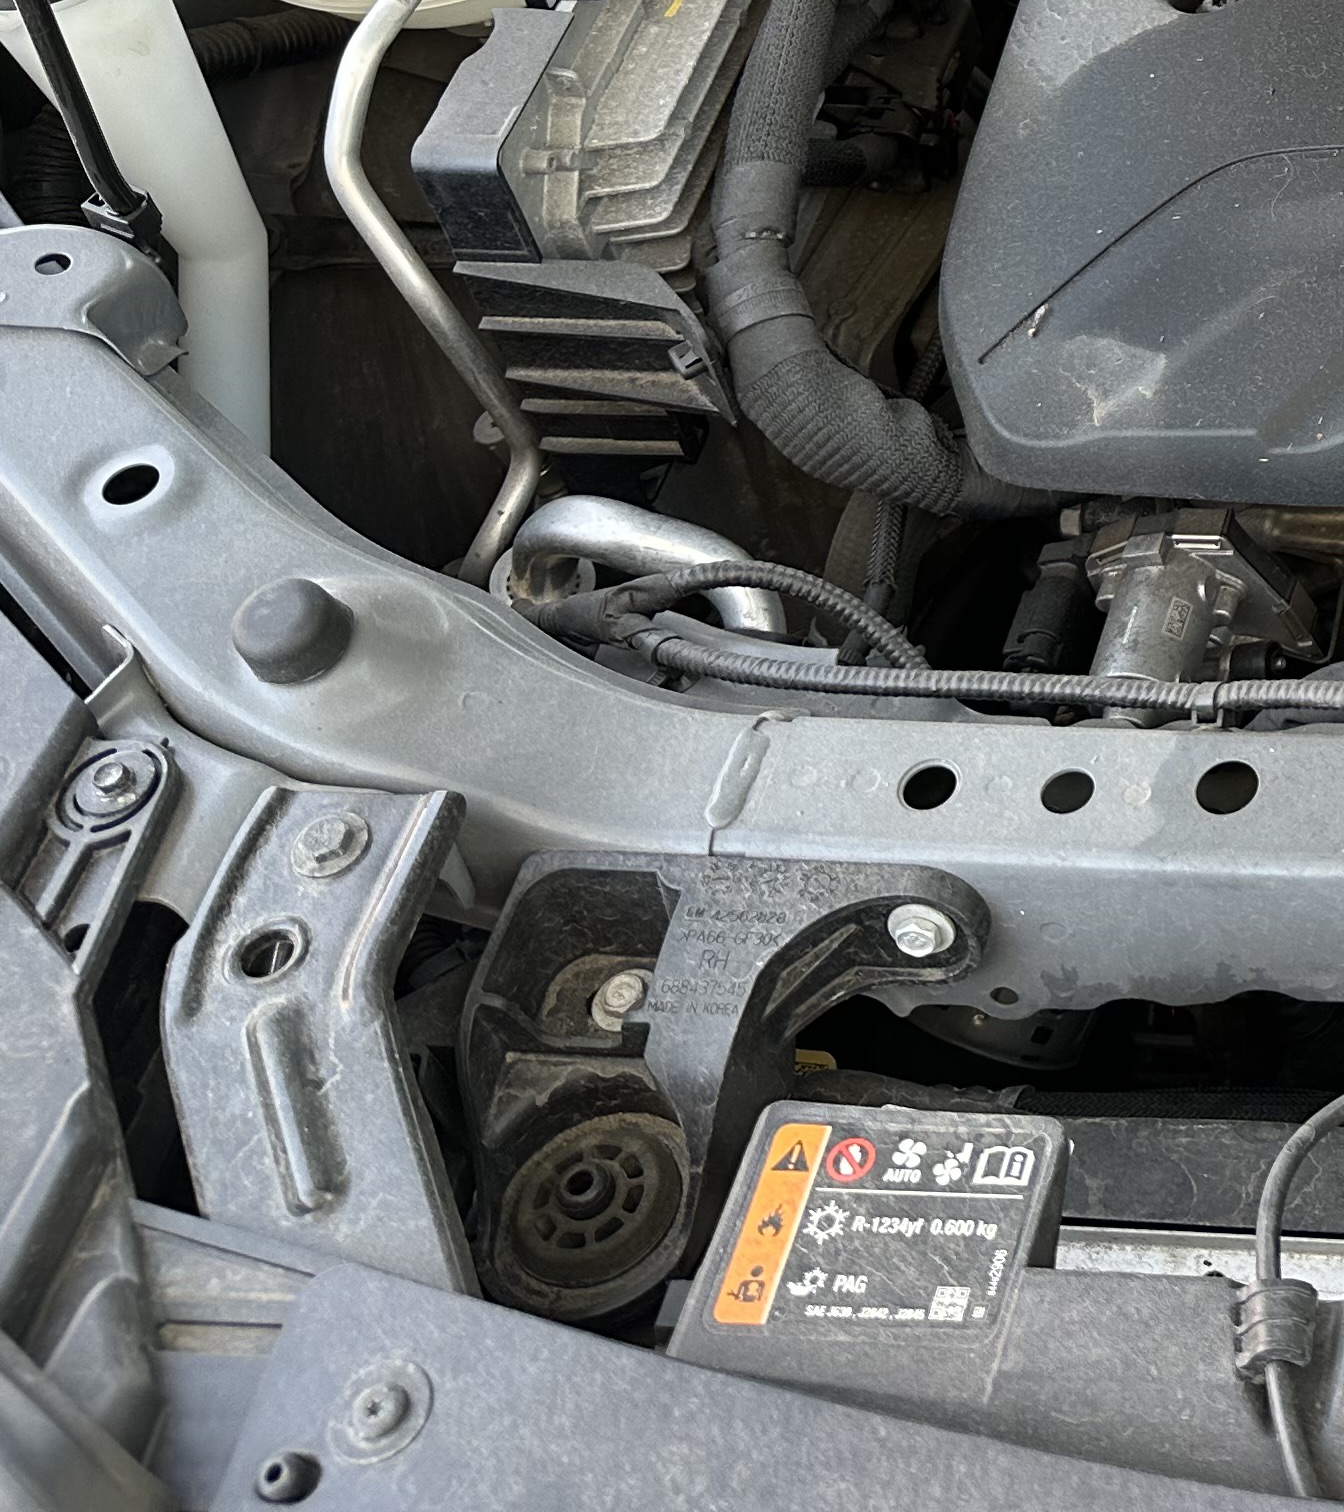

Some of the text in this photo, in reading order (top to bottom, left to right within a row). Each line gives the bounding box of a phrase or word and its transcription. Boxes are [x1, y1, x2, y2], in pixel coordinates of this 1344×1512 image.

[701, 949, 731, 971] RH
[646, 1001, 683, 1014] MADE
[702, 1003, 740, 1017] KOREA
[882, 1168, 922, 1183] AUTO
[850, 1215, 998, 1240] R-1234yf 0.600 kg
[832, 1274, 868, 1293] PAG
[804, 1304, 827, 1317] SAE
